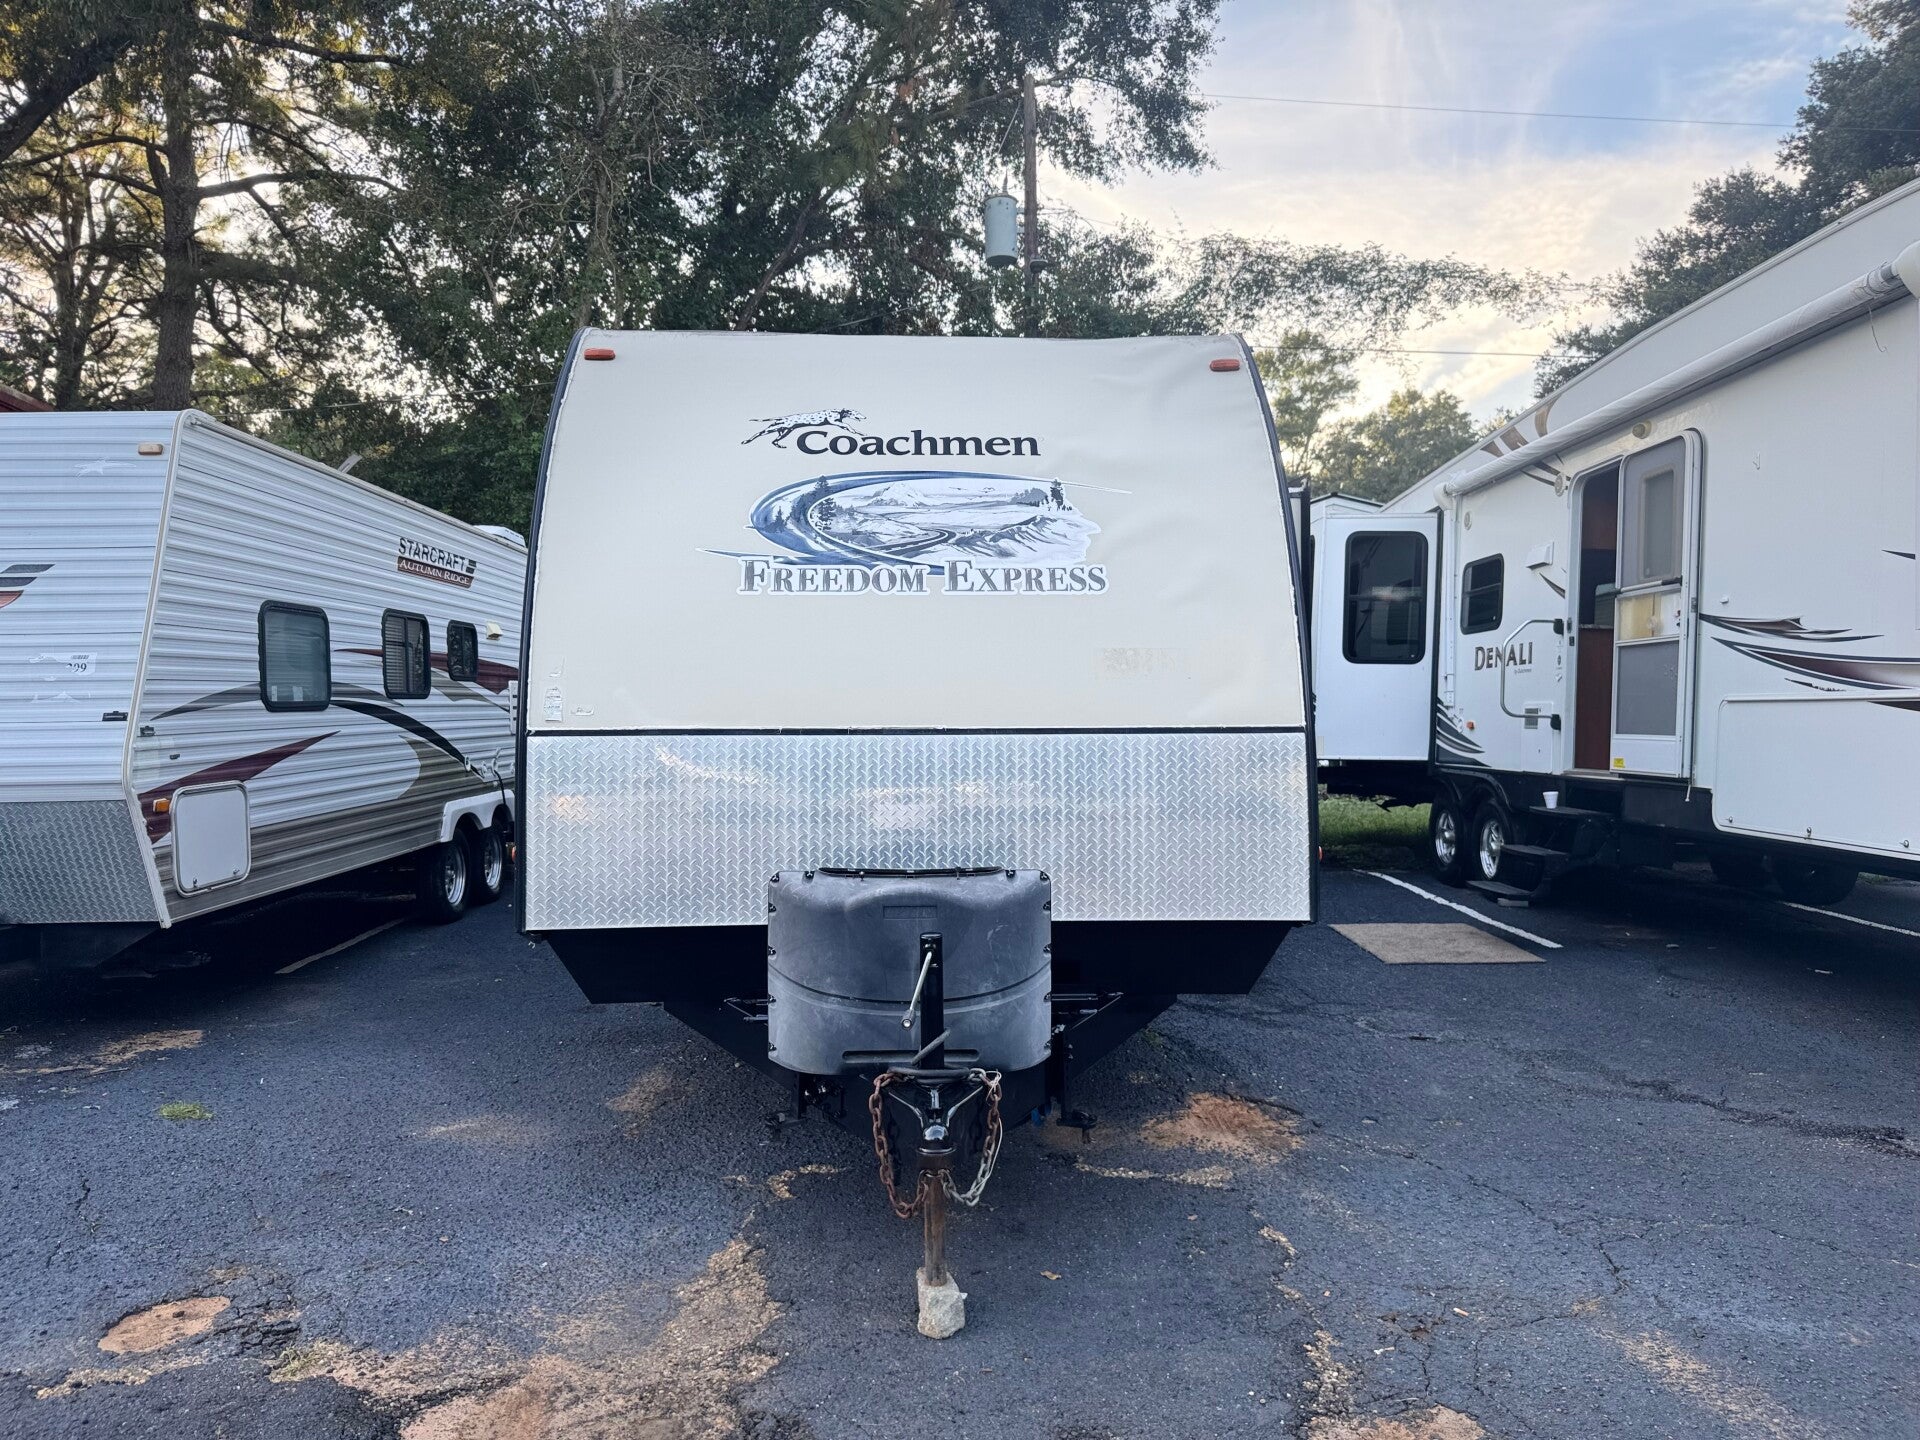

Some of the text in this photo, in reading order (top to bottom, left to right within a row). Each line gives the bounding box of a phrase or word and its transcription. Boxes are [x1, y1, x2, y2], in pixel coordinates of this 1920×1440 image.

[797, 430, 1041, 456] Coachmen
[399, 537, 466, 572] STARCRAFT
[400, 559, 470, 585] AUTUMN RIDGE
[738, 559, 1107, 593] FREEDOM EXPRESS
[1474, 641, 1533, 671] DENALI
